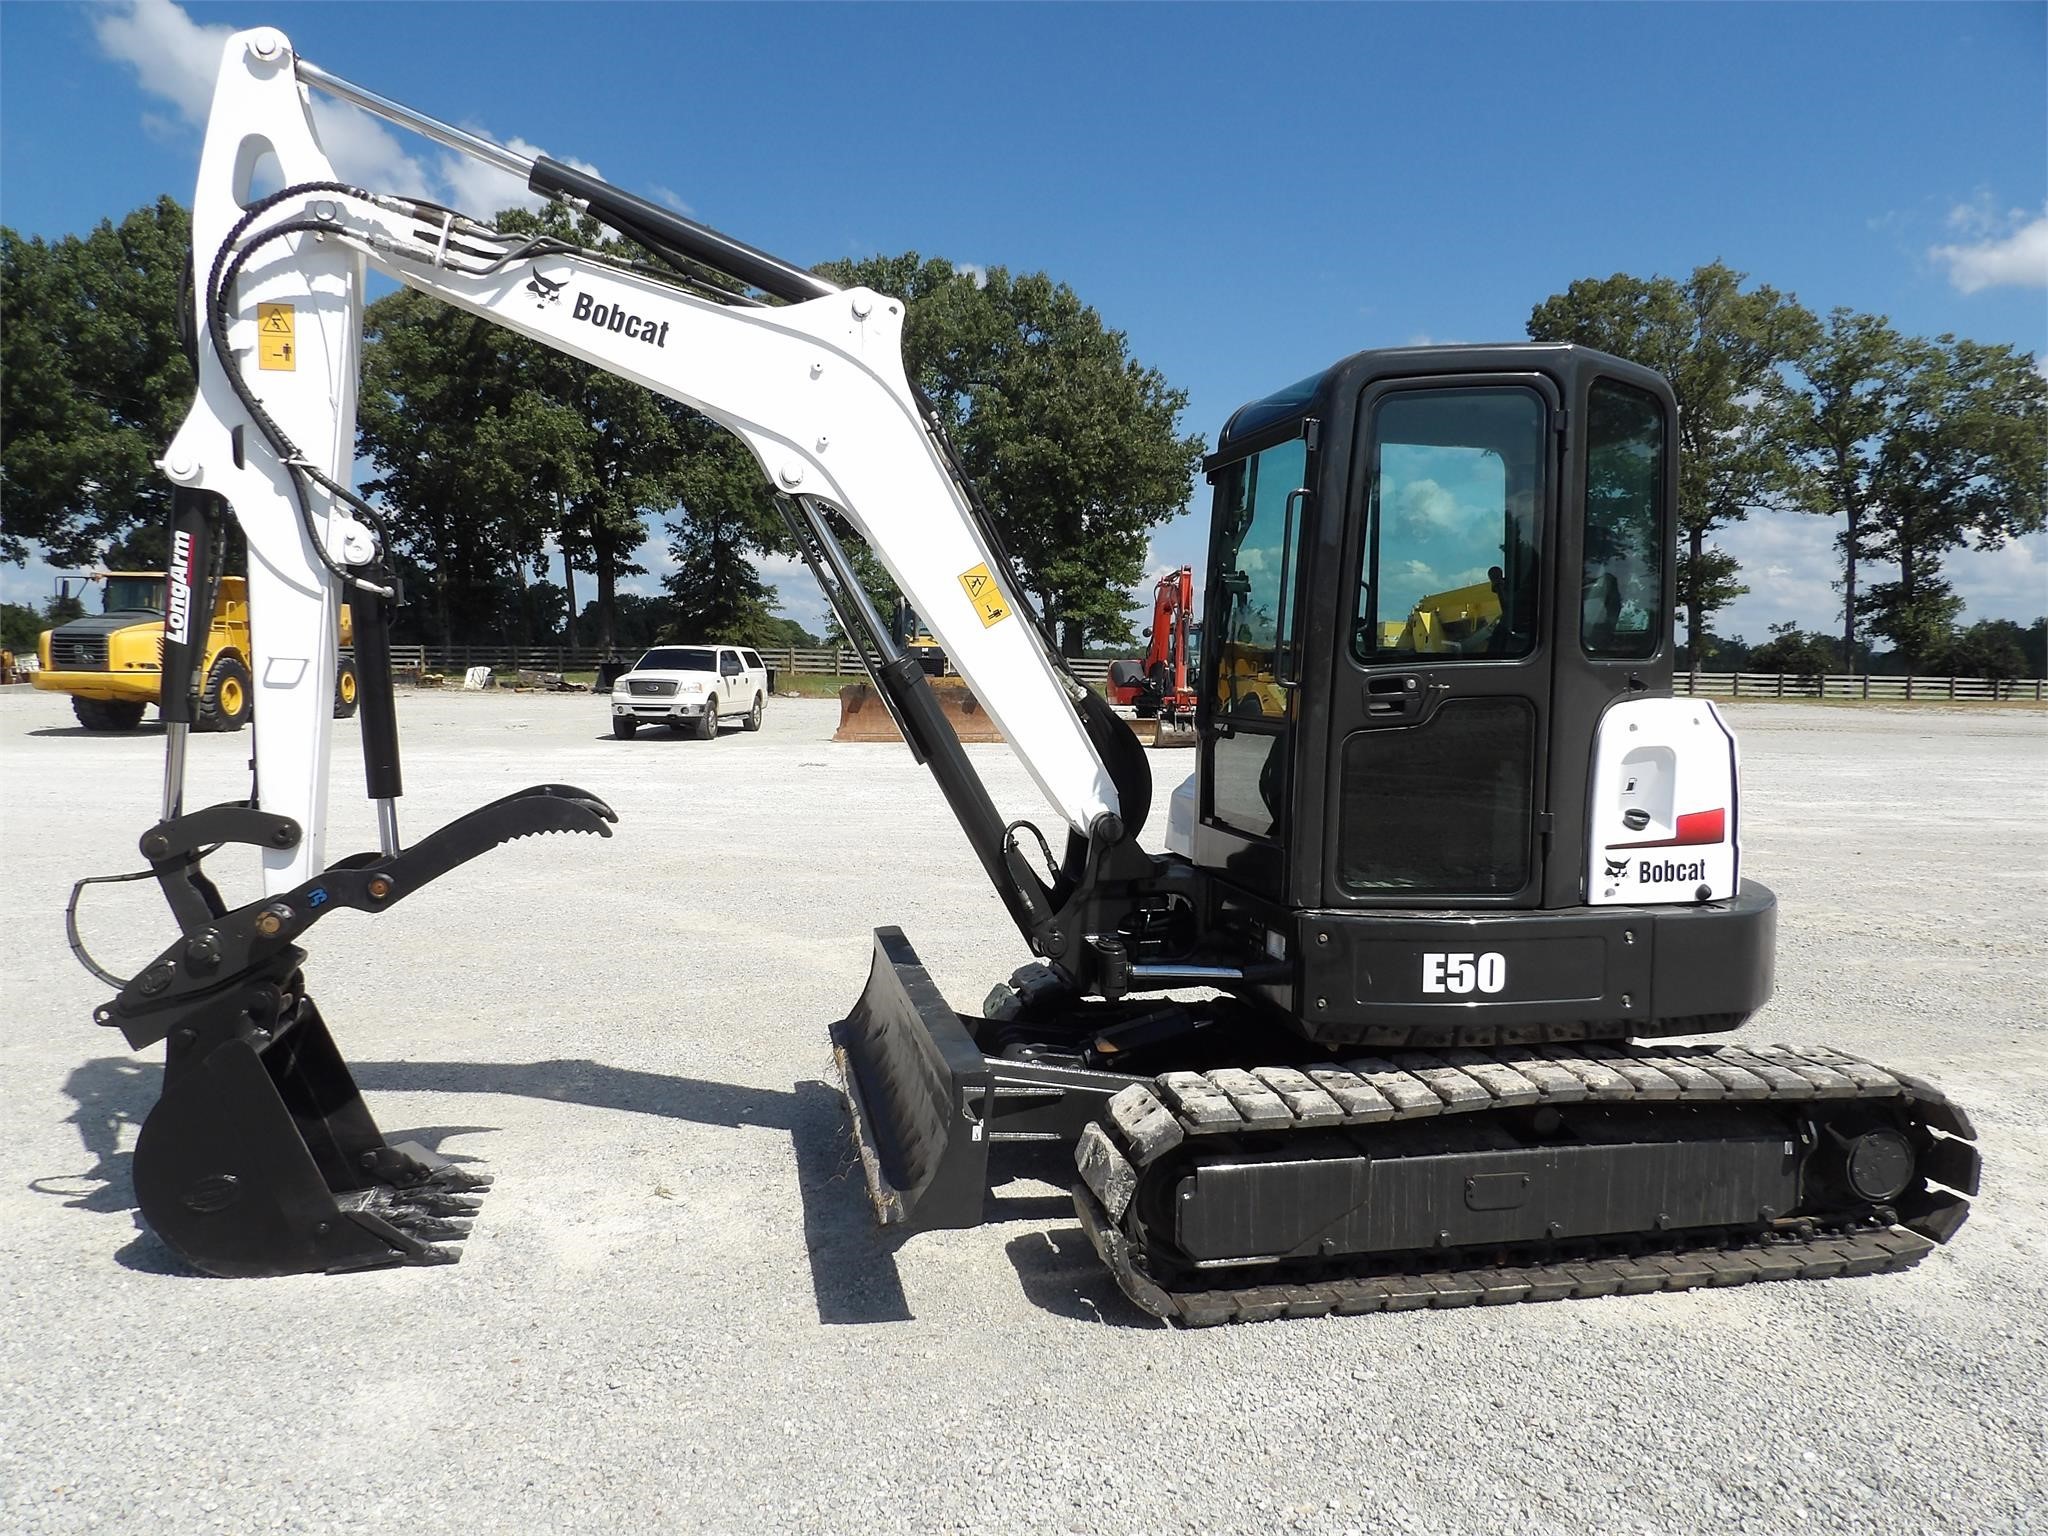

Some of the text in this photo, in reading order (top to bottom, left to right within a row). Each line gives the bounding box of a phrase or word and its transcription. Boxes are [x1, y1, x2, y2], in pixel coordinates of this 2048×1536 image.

[572, 291, 669, 348] Bobcat
[166, 530, 191, 645] LongArm
[1639, 859, 1705, 883] Bobcat
[1423, 952, 1506, 994] E50
